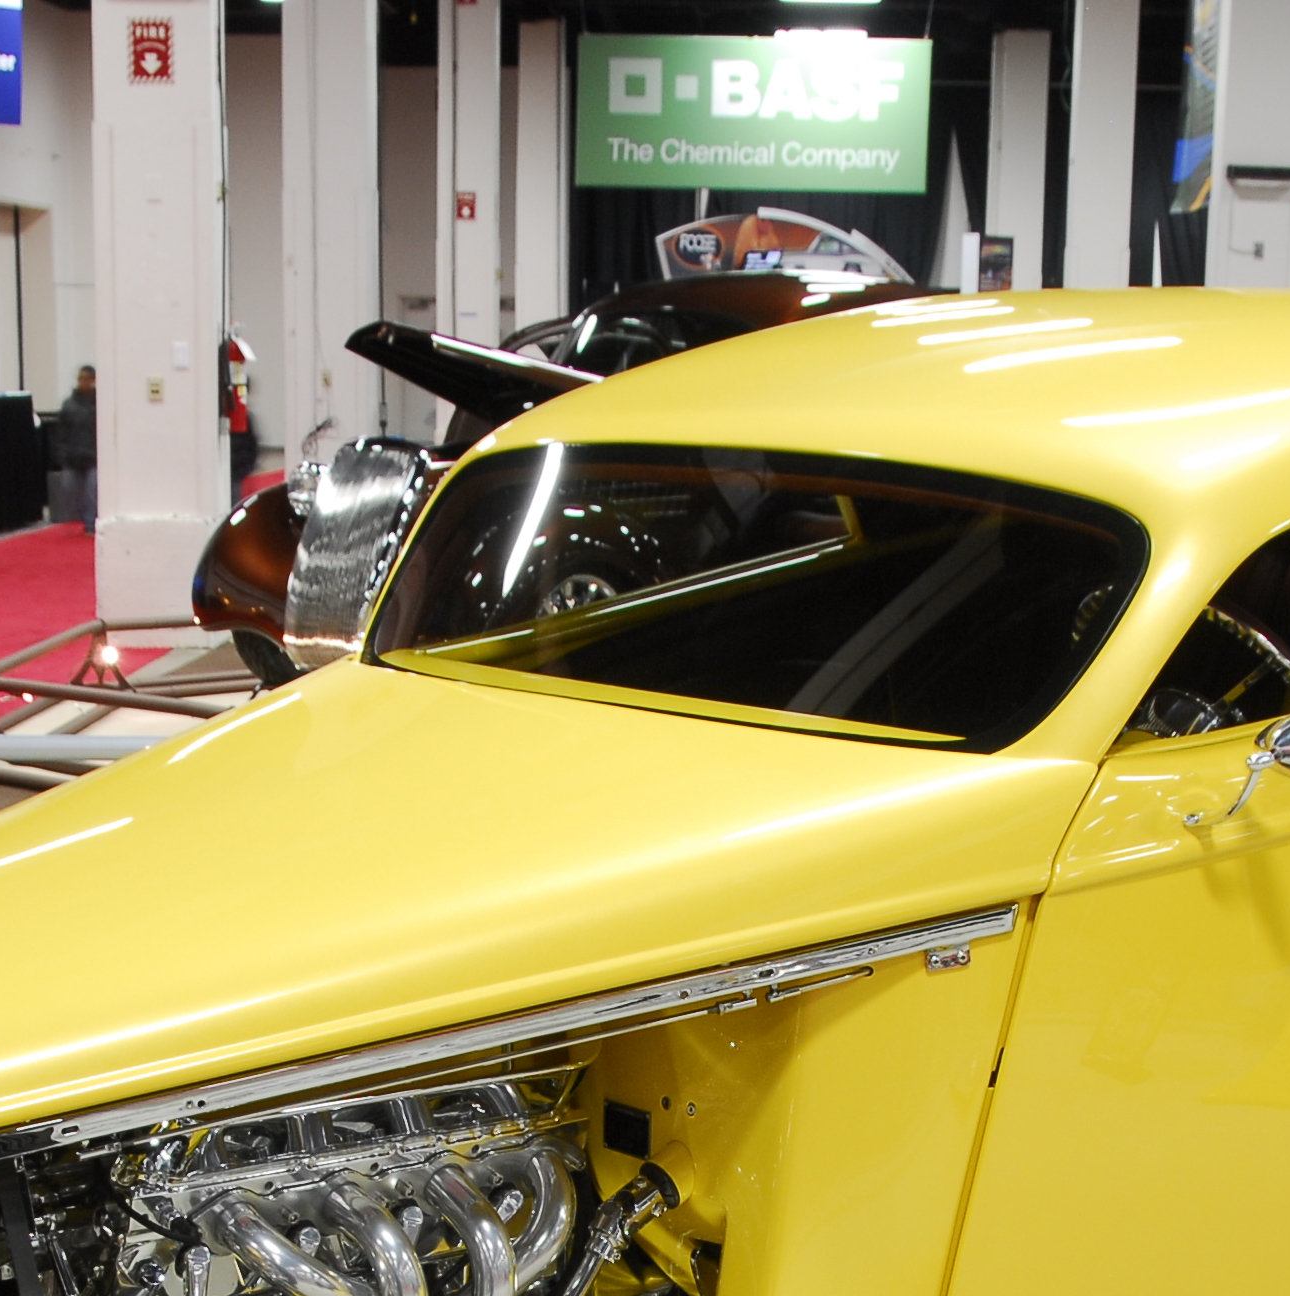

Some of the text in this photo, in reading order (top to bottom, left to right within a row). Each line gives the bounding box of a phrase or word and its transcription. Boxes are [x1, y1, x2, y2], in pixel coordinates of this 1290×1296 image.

[135, 25, 166, 40] FIRE
[711, 59, 905, 122] BASF
[608, 138, 900, 174] The Chemical Company
